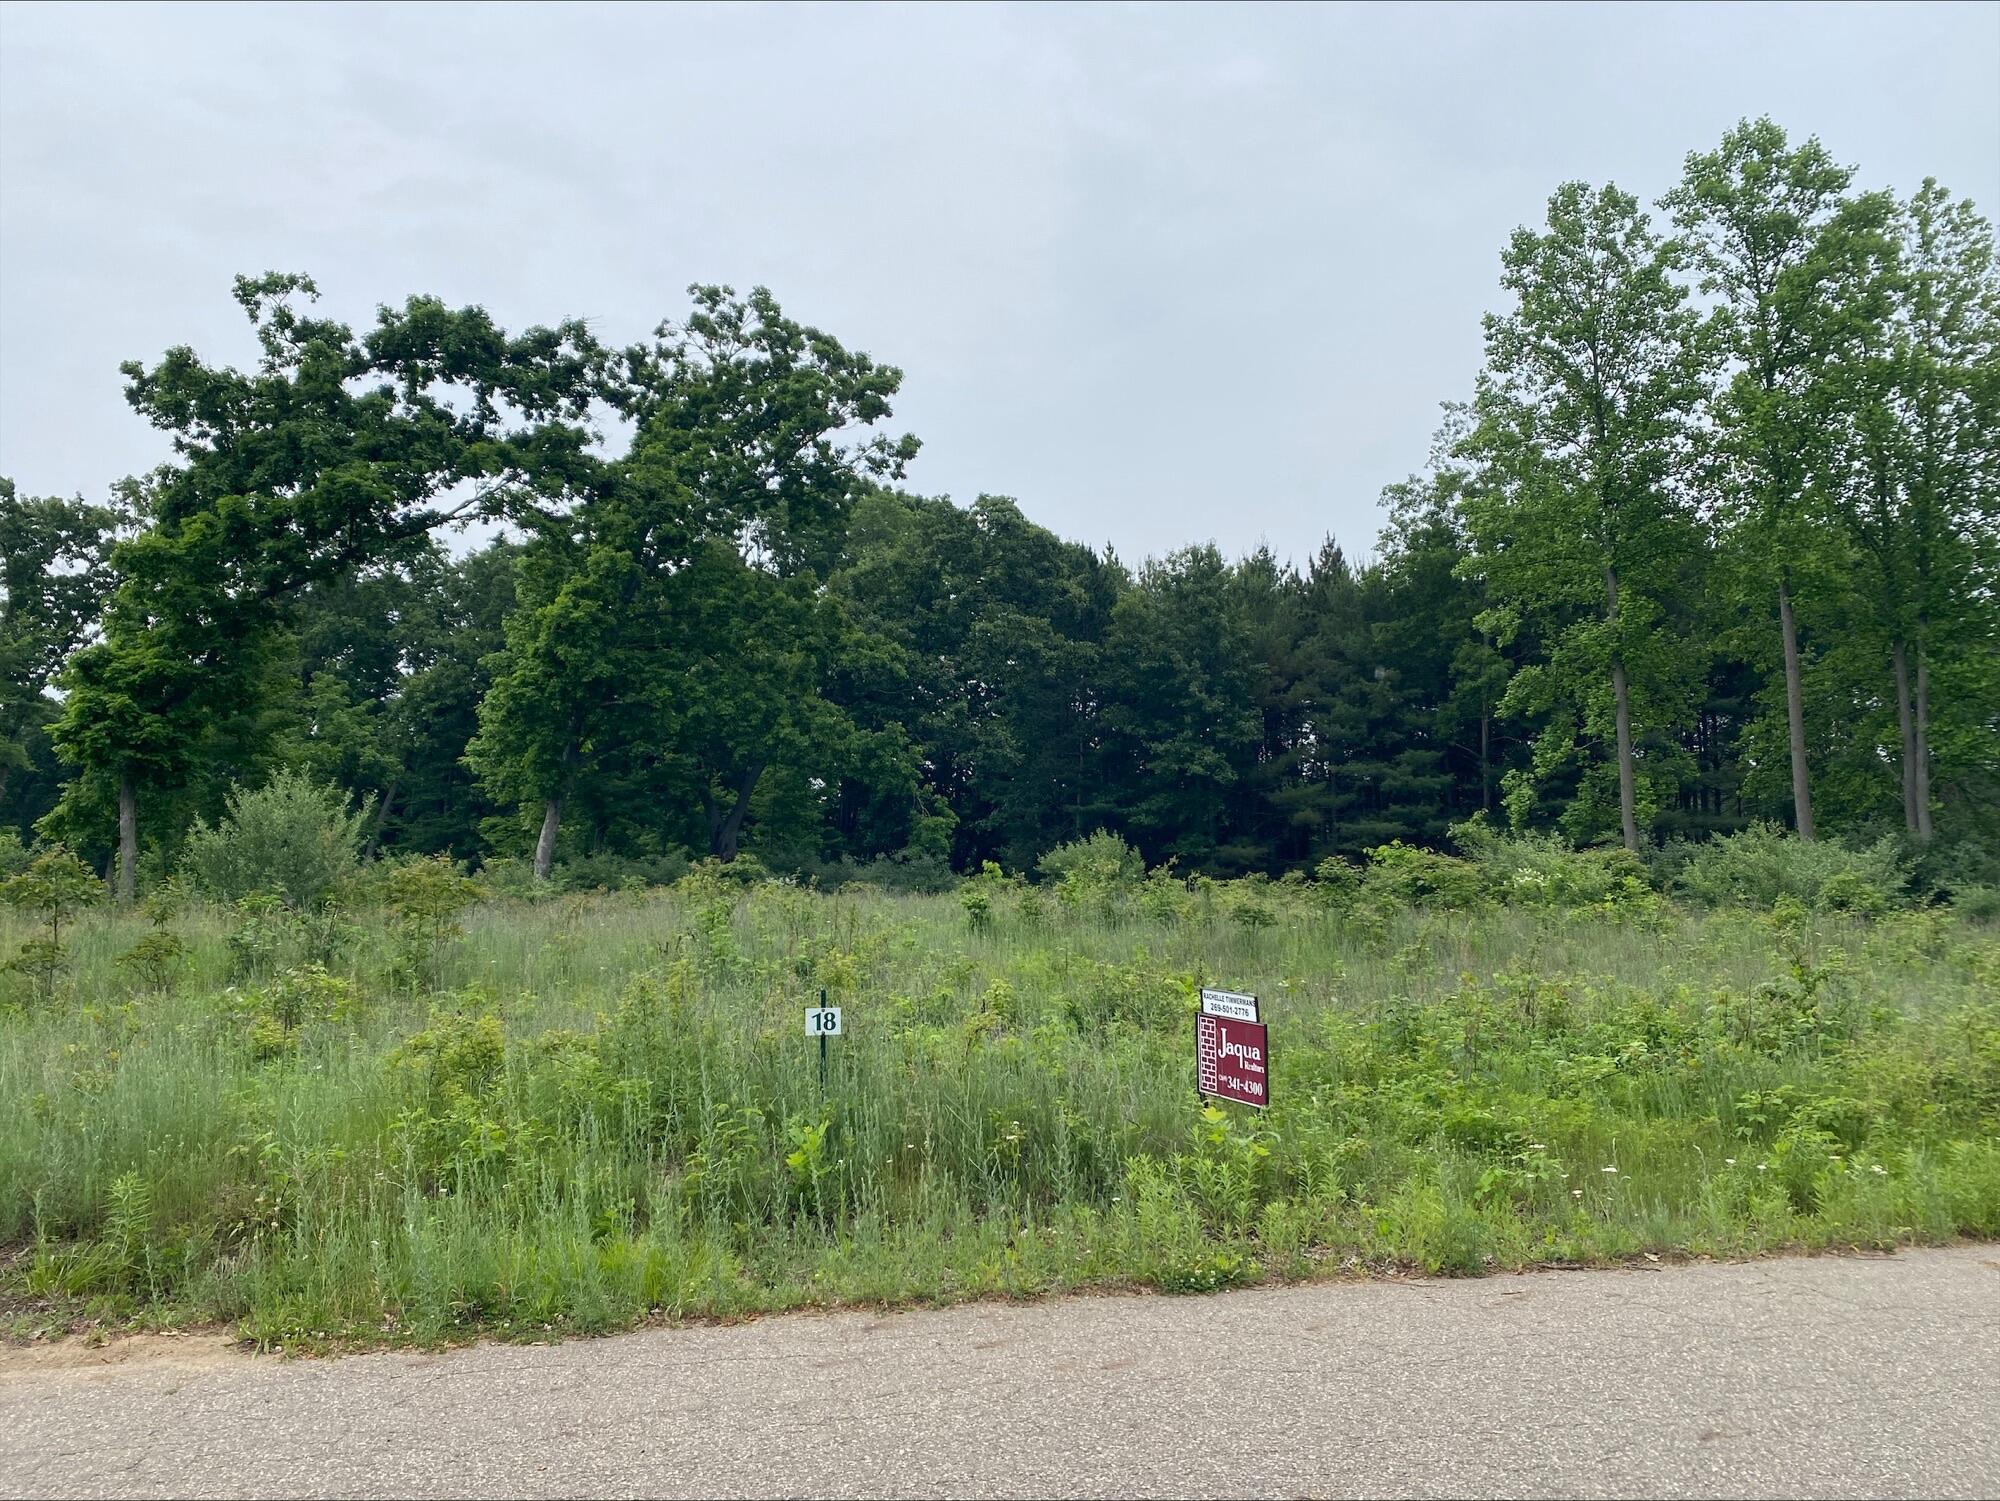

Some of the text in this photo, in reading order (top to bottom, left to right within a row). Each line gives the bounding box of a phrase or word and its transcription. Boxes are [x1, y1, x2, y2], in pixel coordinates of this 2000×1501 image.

[1203, 992, 1225, 1003] RACHELLE
[1210, 1003, 1250, 1017] 269-501-2776
[811, 1012, 836, 1031] 18
[1218, 1027, 1261, 1069] Jaqua
[1227, 1076, 1263, 1096] 341-4300
